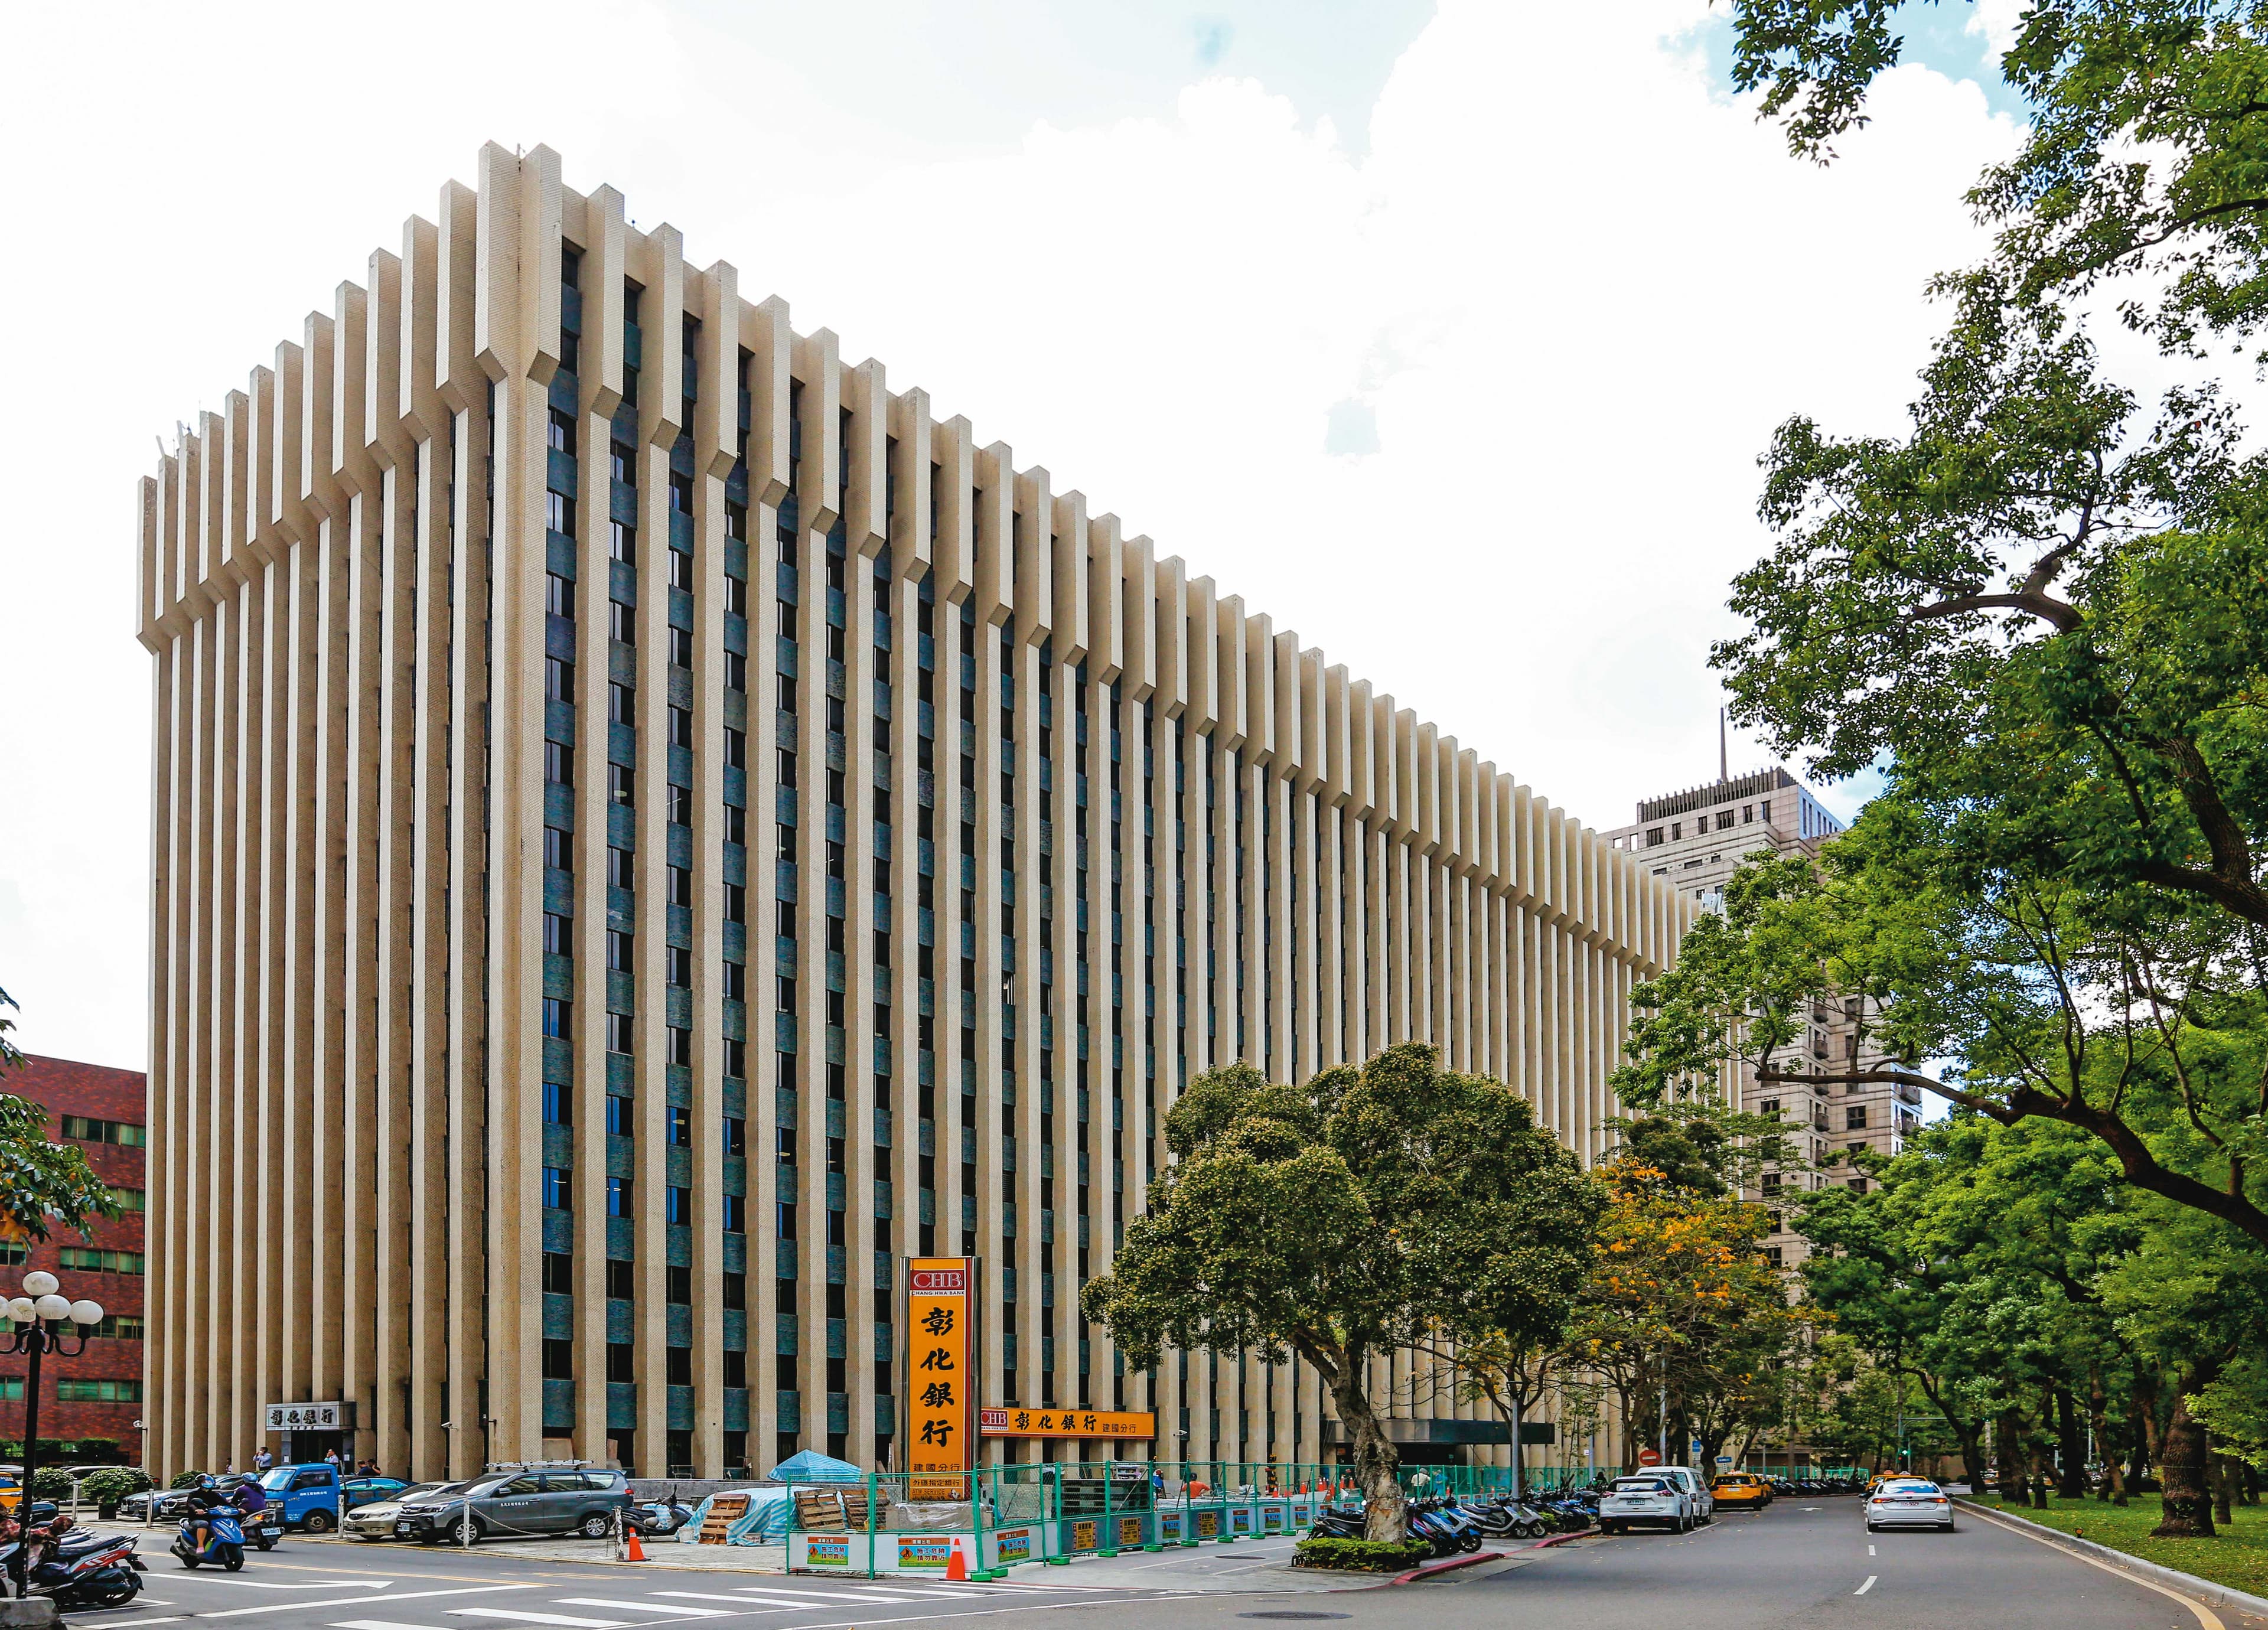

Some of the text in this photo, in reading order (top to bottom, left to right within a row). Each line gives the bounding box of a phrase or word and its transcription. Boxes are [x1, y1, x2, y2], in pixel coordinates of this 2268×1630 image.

[914, 1272, 963, 1288] CHB
[920, 1307, 954, 1448] 彰化銀行
[981, 1412, 1006, 1424] CHB
[1015, 1411, 1097, 1432] 彰化銀行
[1103, 1423, 1137, 1433] 建國分行
[913, 1463, 961, 1472] 建國分行
